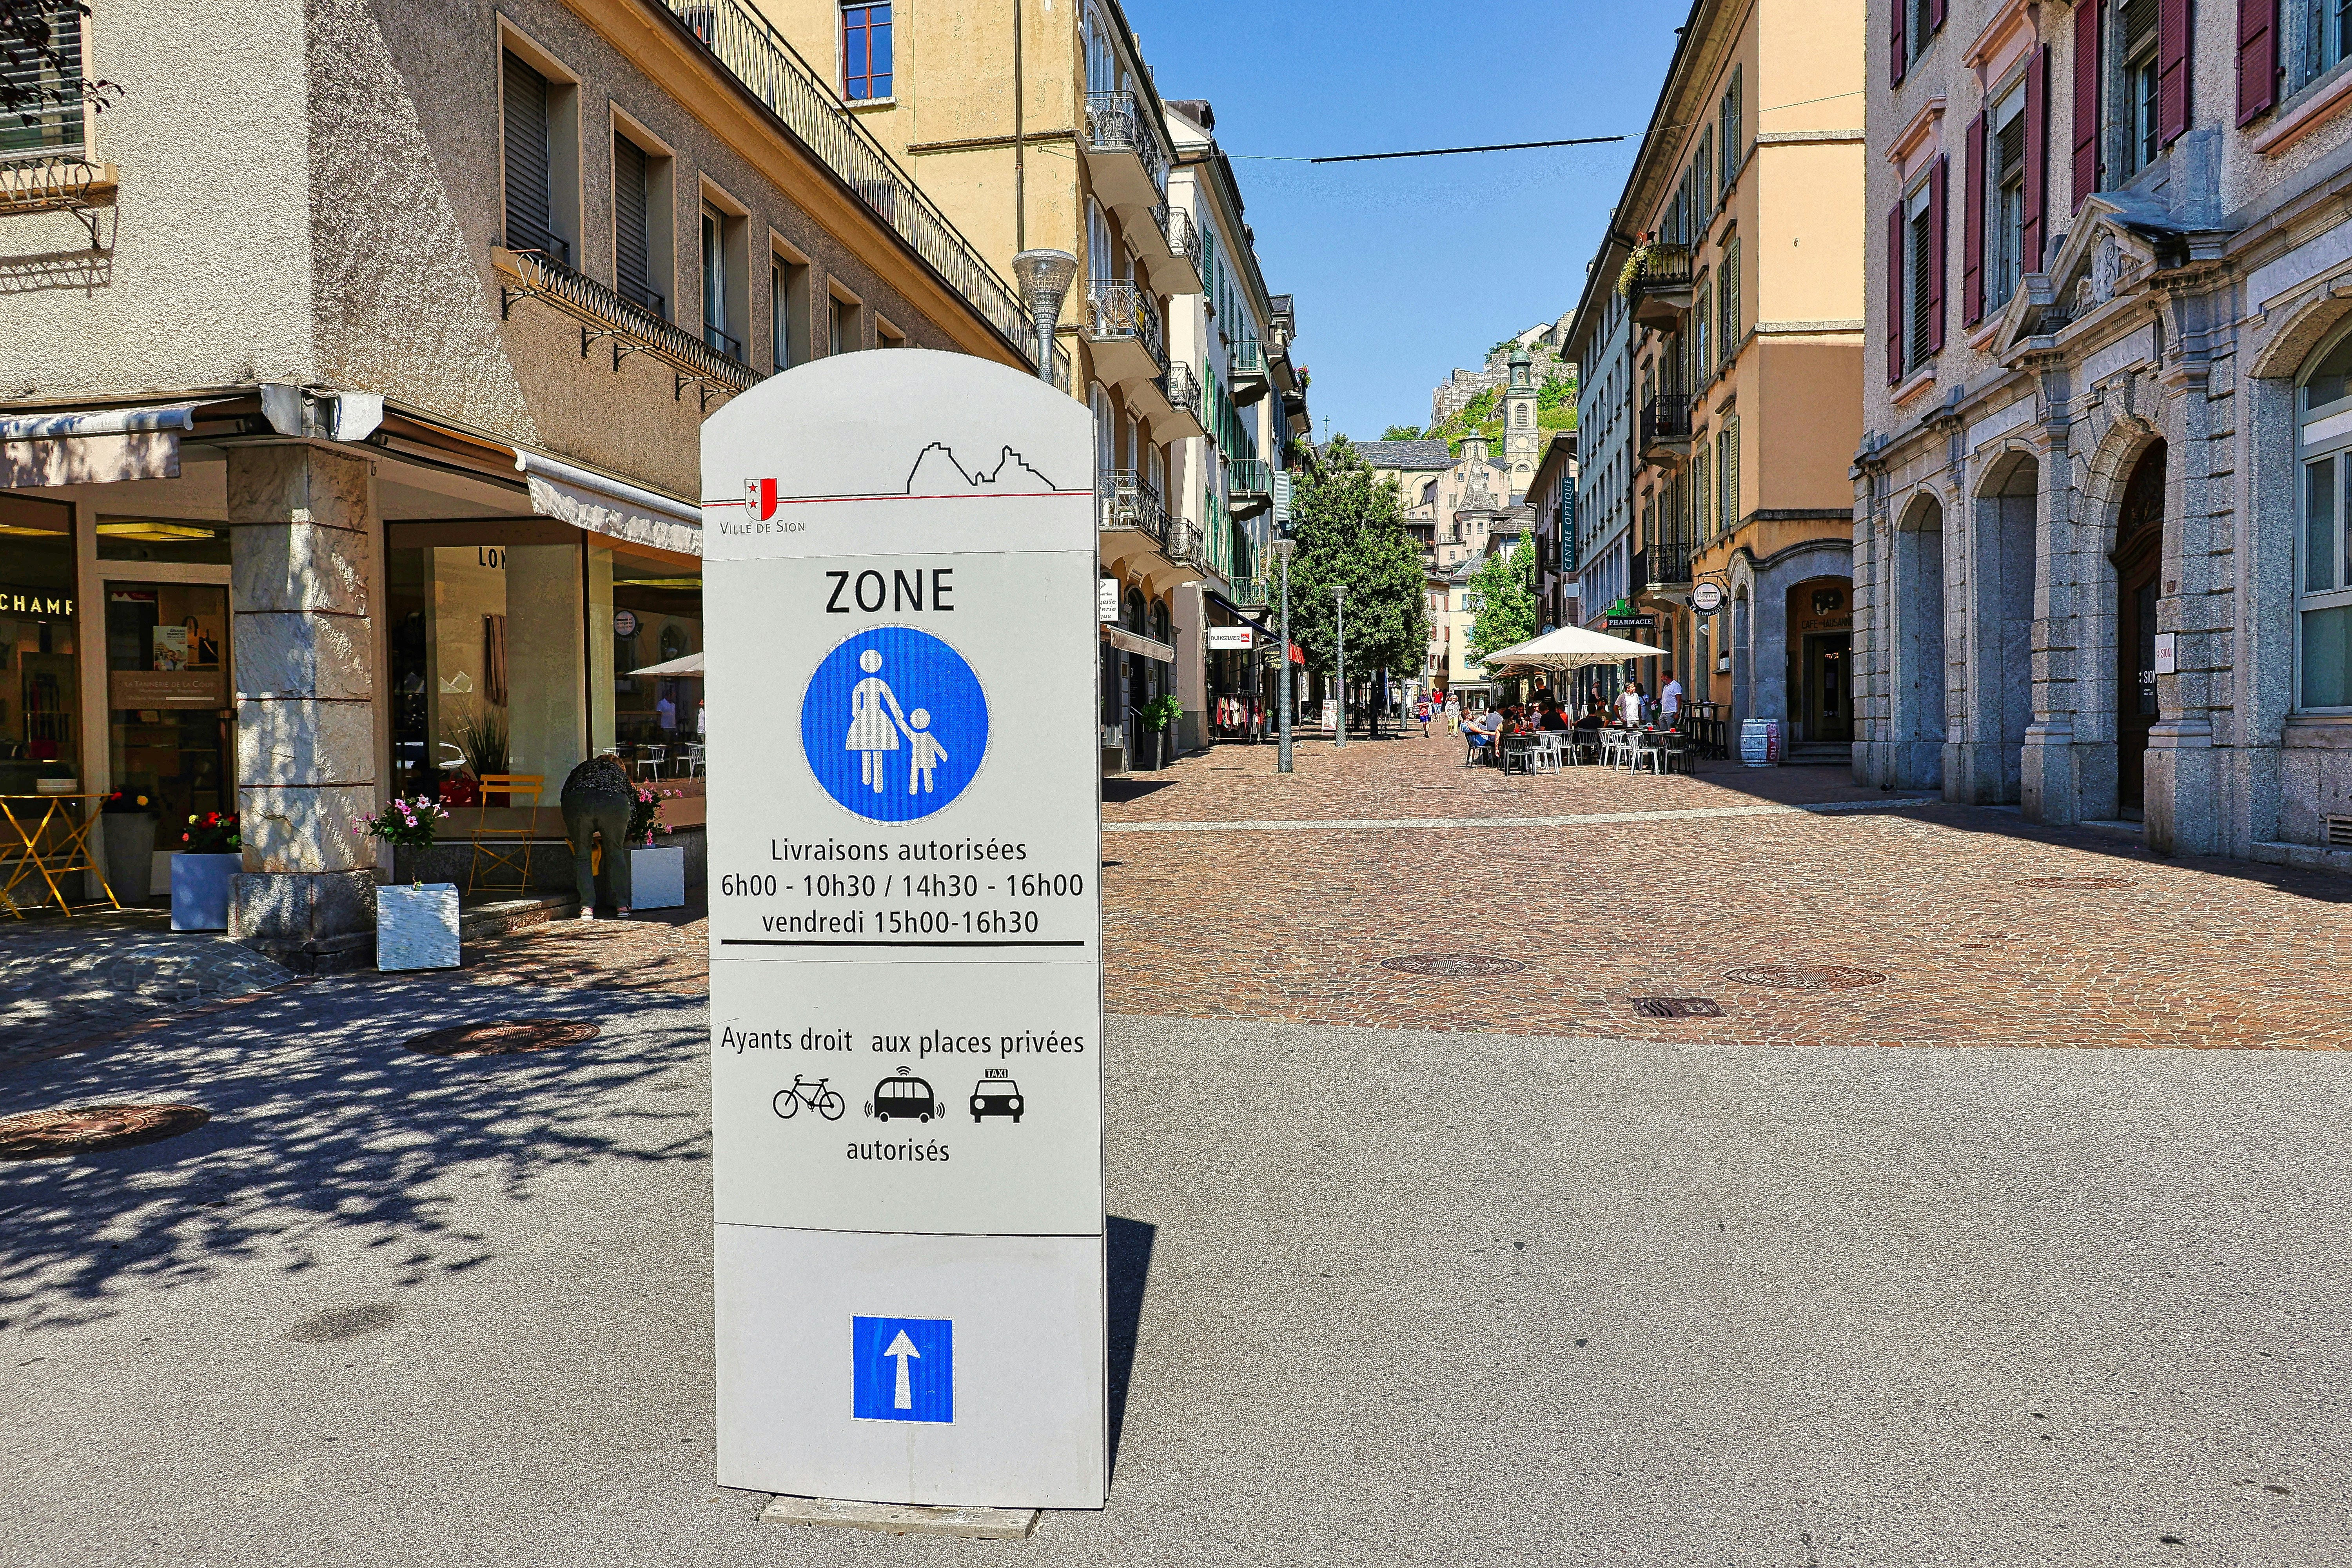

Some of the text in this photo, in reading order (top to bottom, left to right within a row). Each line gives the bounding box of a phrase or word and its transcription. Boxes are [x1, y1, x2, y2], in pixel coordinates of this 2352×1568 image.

[1564, 479, 1573, 525] OPTIQUE
[826, 568, 955, 613] ZONE
[1698, 605, 1724, 616] COMPTOIR
[2161, 648, 2171, 658] SION
[2144, 670, 2156, 684] SION
[772, 838, 1027, 861] Livraisons autorisées
[722, 874, 776, 897] 6h00
[804, 874, 875, 897] 10h30
[884, 875, 892, 897] /
[903, 874, 977, 897] 14h30
[1007, 873, 1083, 897] 16h00
[762, 910, 1038, 933] vendredi 15h00-16h30
[721, 1026, 1084, 1060] Ayants droit aux places privées
[986, 1069, 1006, 1078] TAXI
[847, 1138, 949, 1161] autorisés
